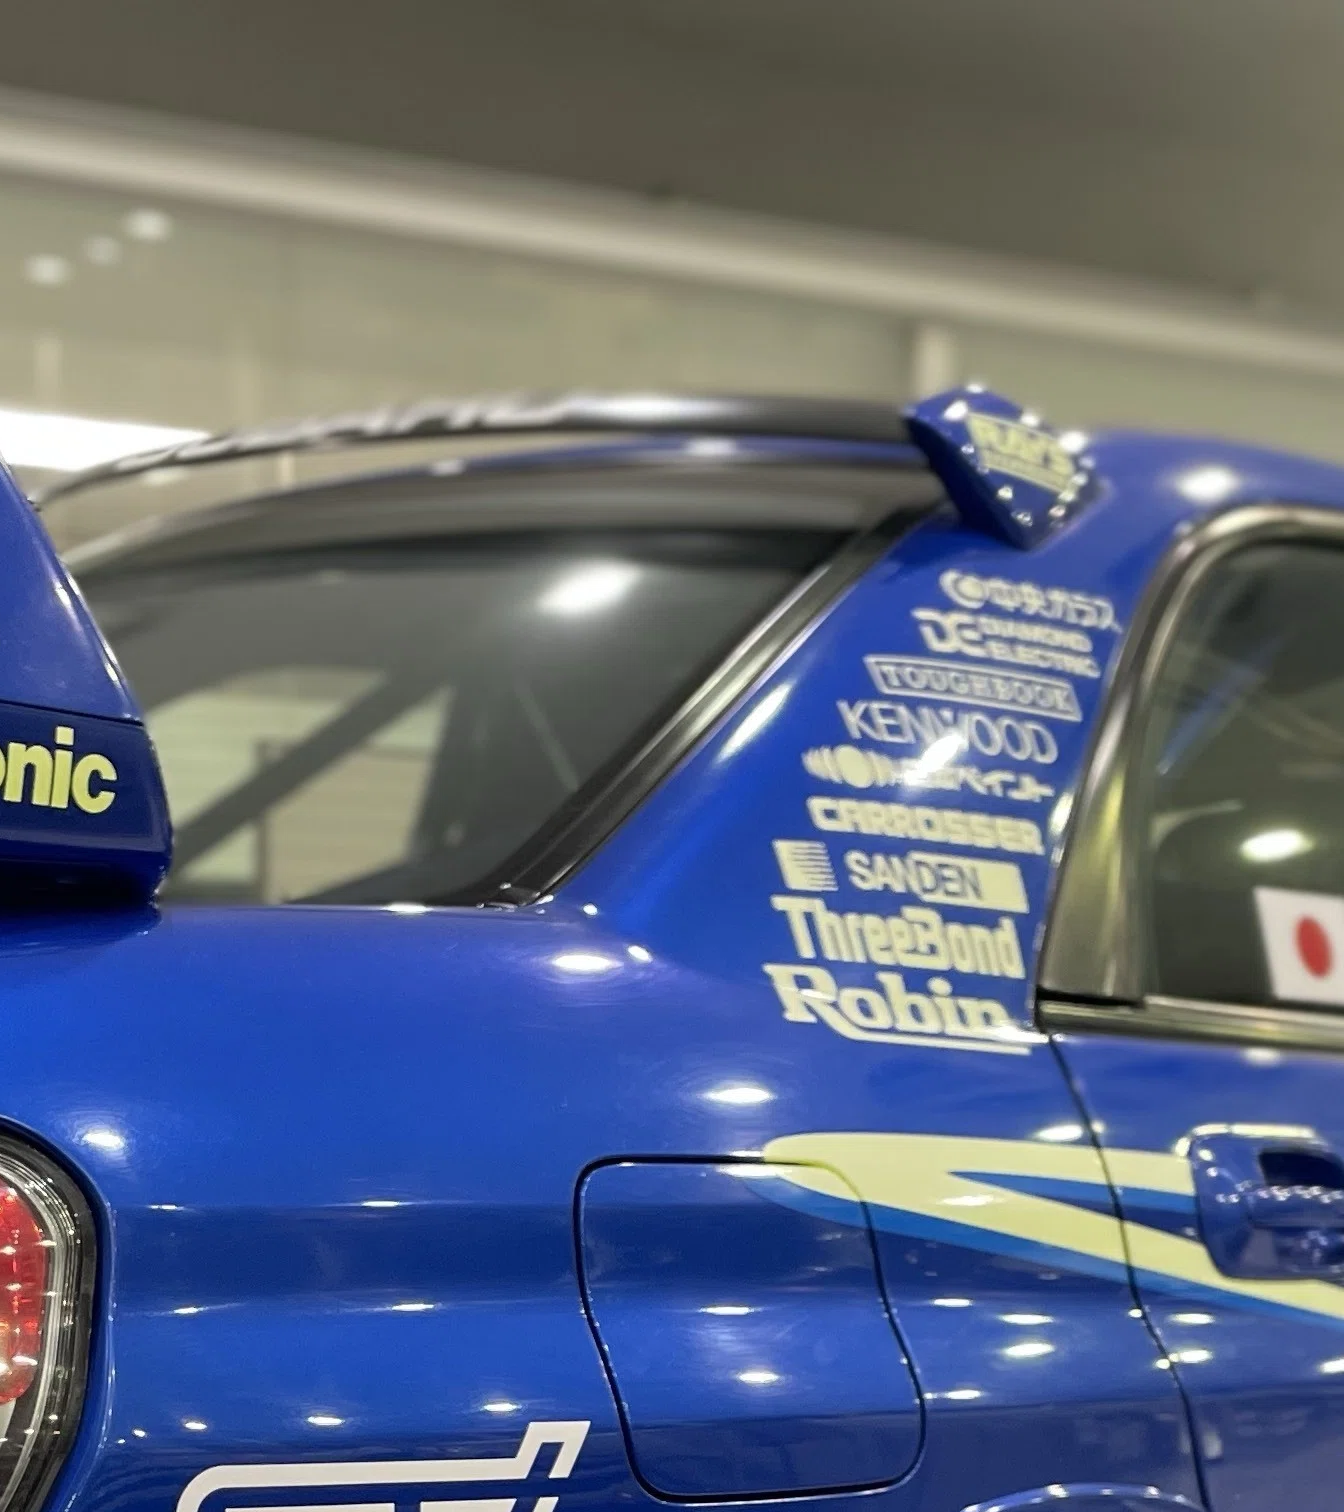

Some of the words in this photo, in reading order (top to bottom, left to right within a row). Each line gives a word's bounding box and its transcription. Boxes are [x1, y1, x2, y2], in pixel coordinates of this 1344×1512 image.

[880, 665, 1076, 717] TOUGHBOOK
[836, 700, 1058, 764] KENWOOD
[807, 796, 1045, 855] CARROSSER
[844, 850, 983, 900] SANDEN
[770, 895, 1026, 979] ThreeBond
[762, 963, 1033, 1055] Robin
